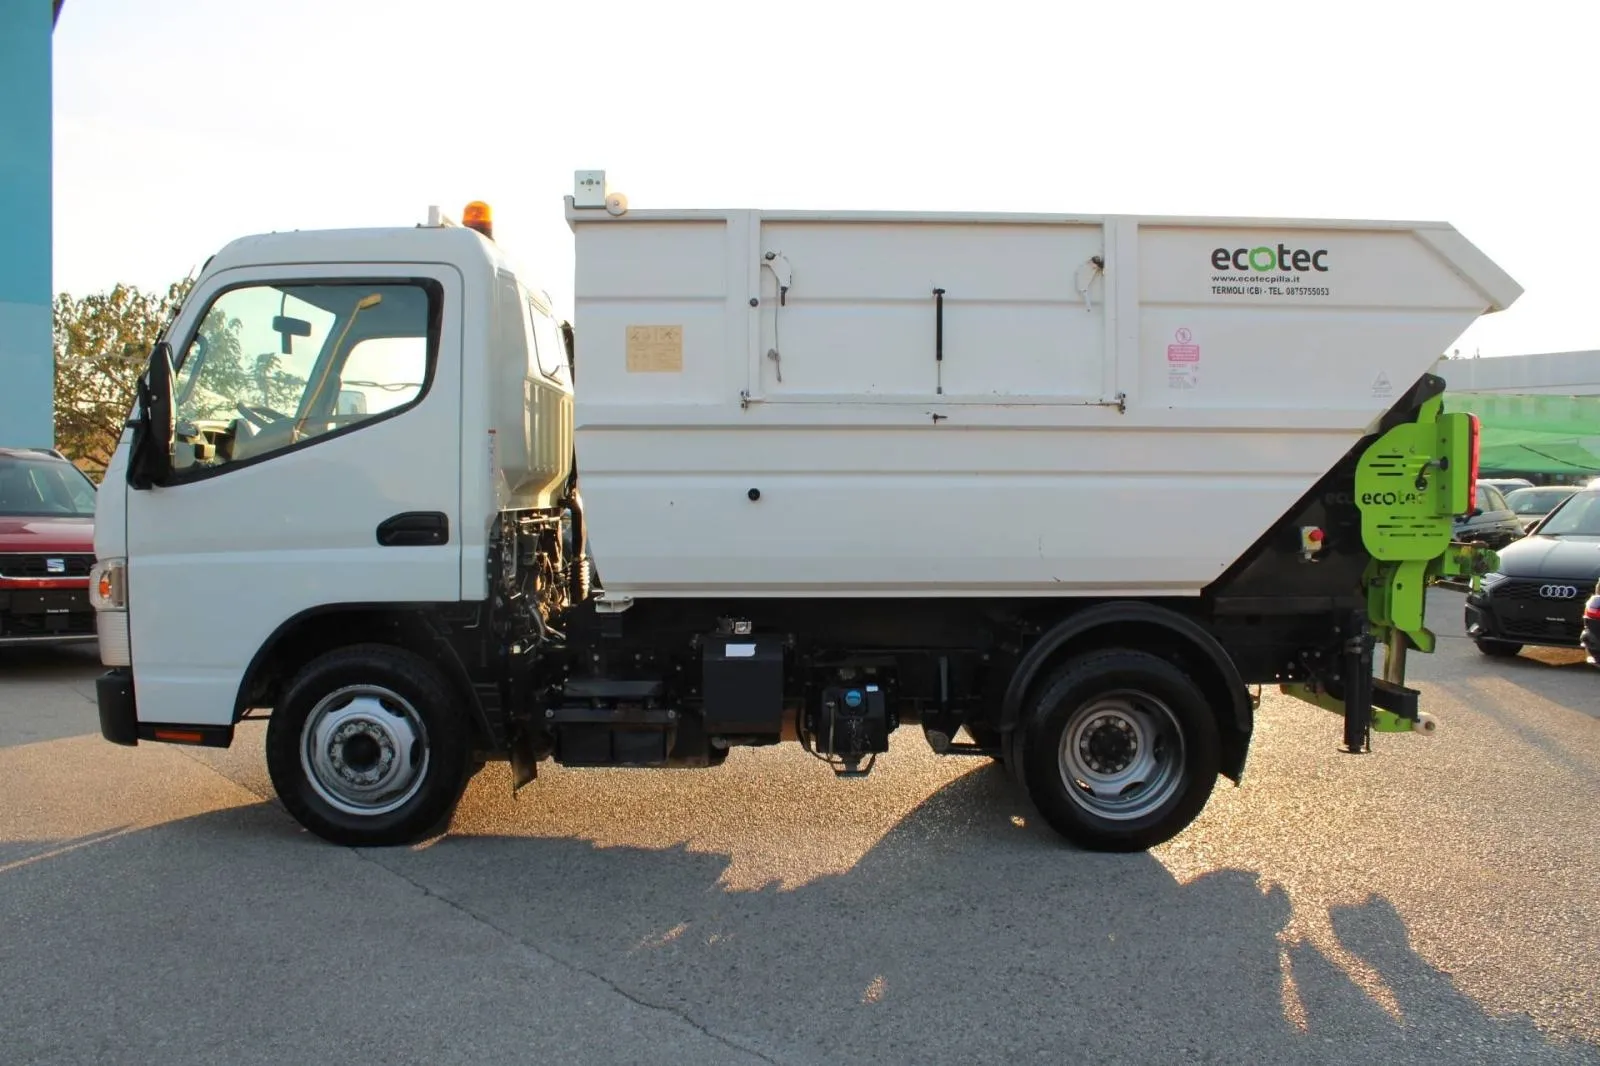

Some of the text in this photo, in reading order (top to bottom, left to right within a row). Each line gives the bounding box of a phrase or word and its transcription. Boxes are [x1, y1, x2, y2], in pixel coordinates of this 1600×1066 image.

[1211, 243, 1329, 272] ecotec
[1211, 275, 1301, 284] www.ecotecpilla.it
[1211, 286, 1245, 295] TERMOLI
